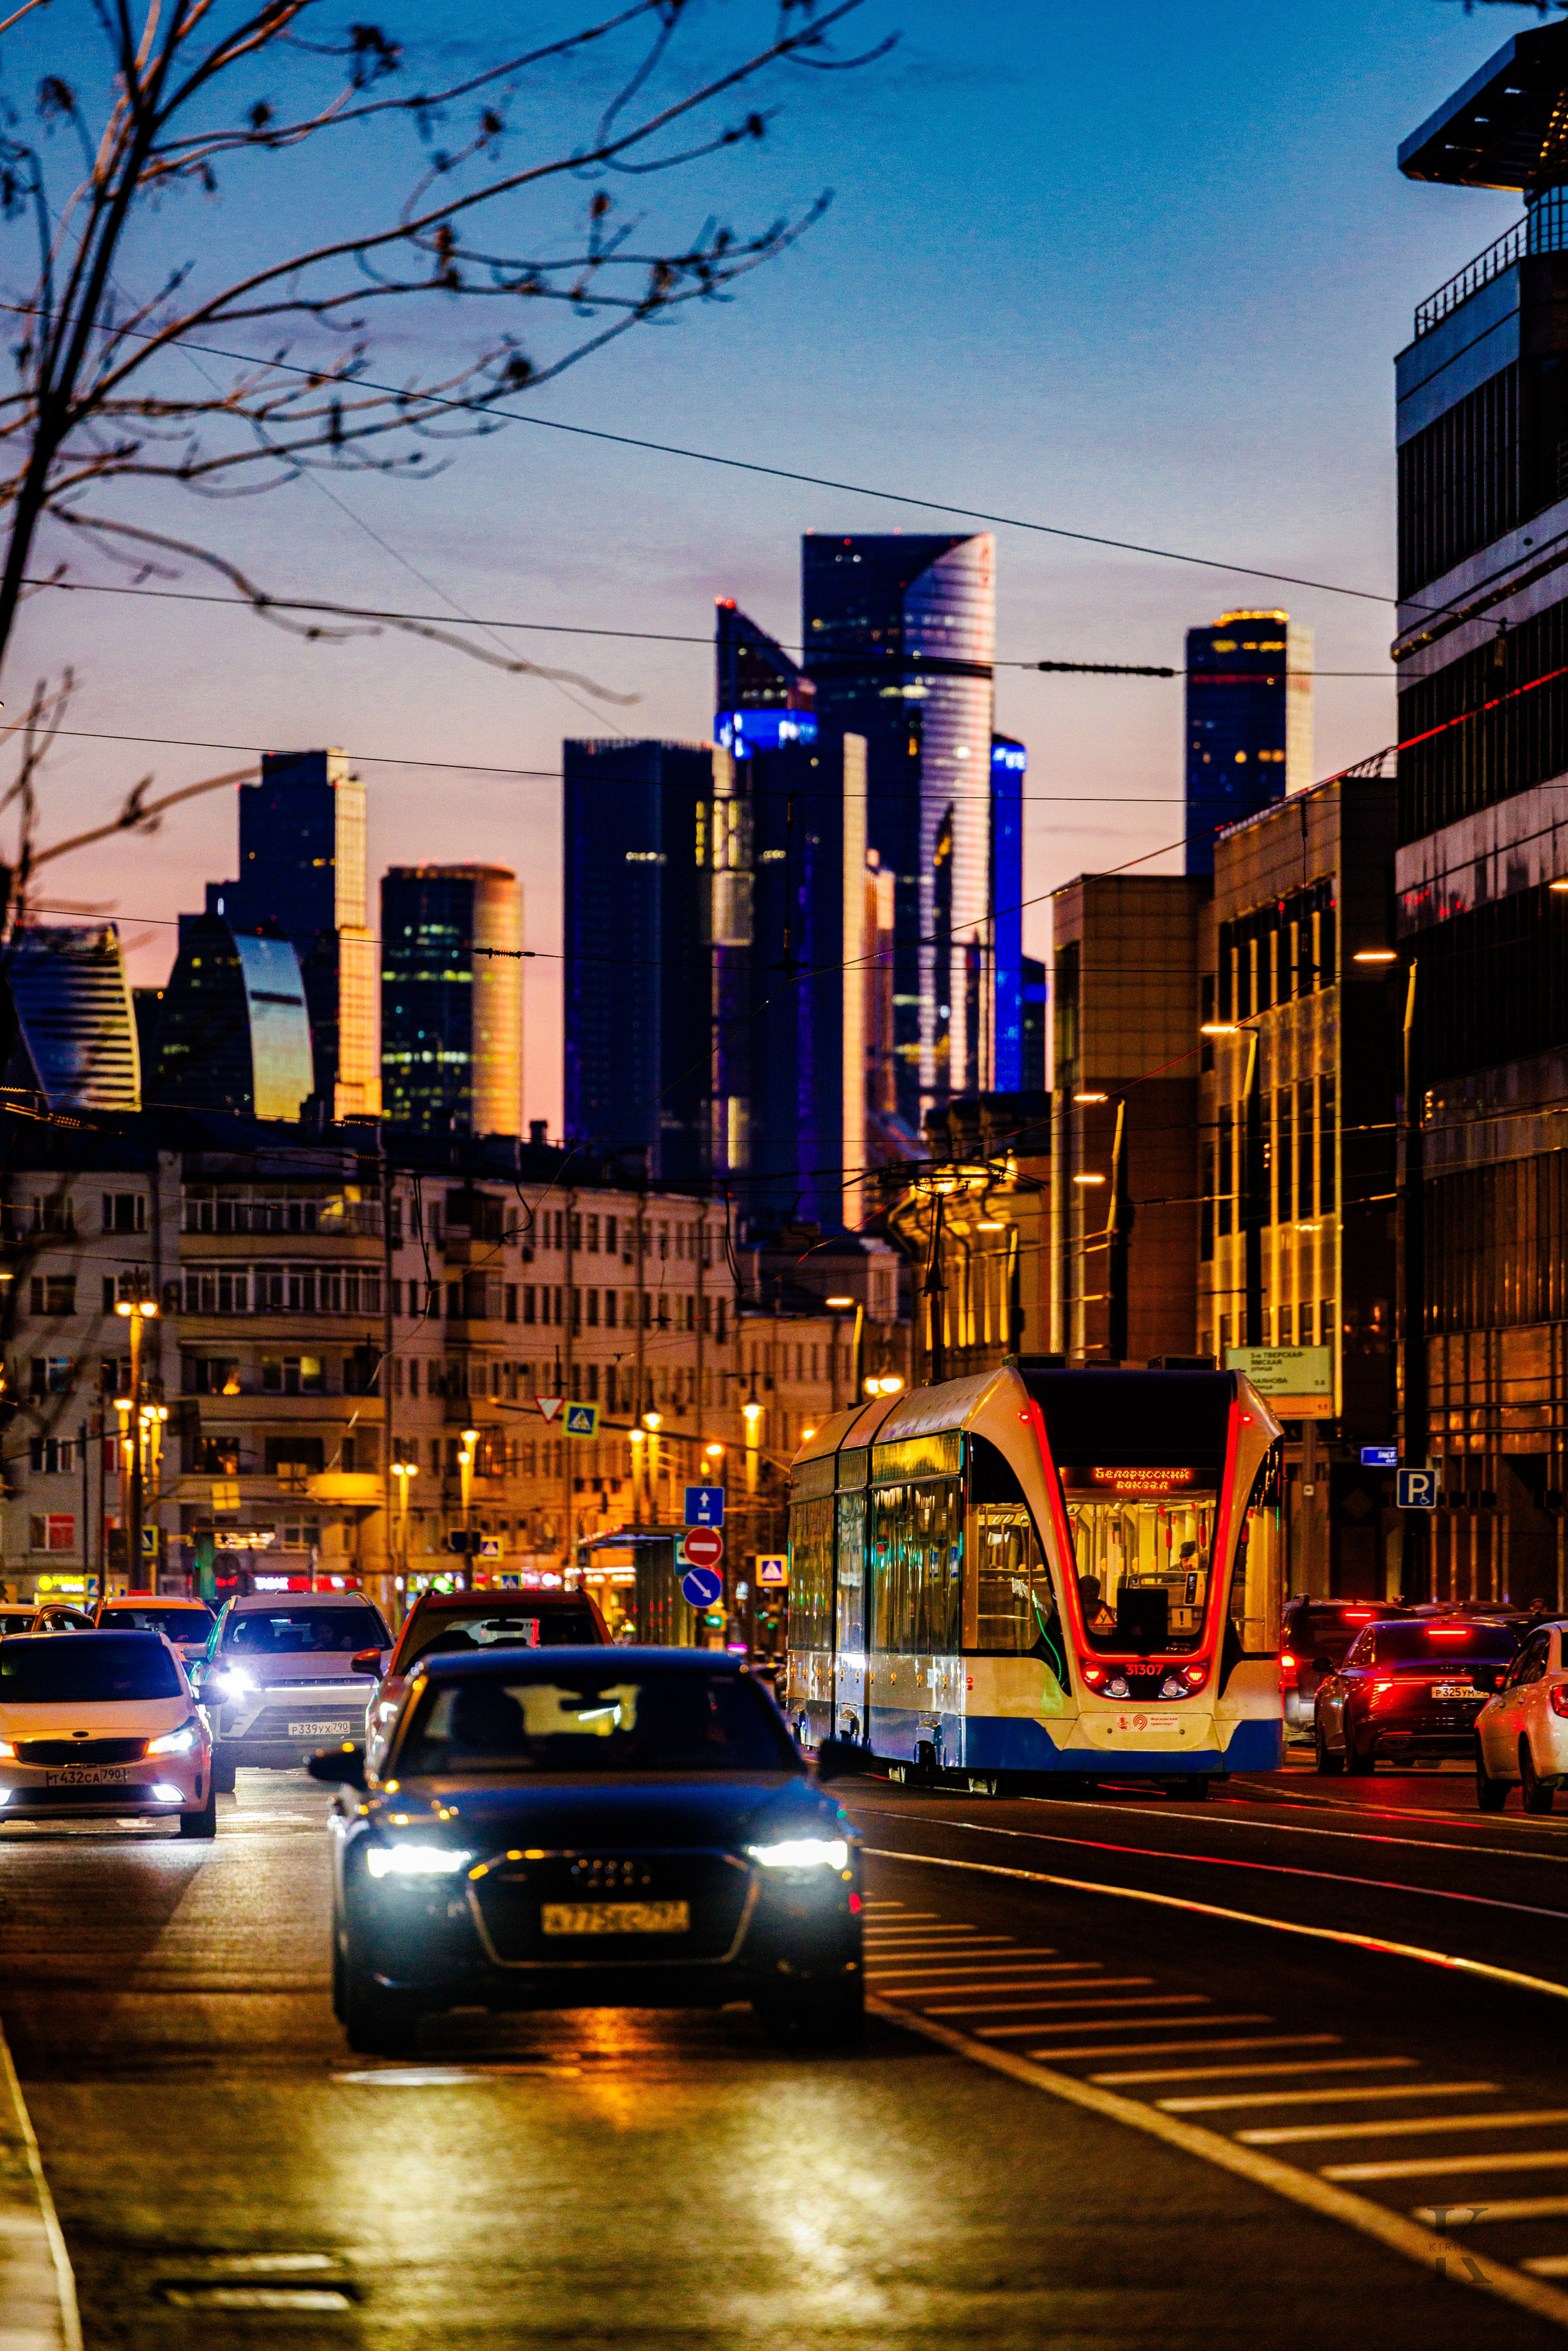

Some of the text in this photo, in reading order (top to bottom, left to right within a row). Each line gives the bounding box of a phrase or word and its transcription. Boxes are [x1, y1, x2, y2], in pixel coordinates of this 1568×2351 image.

[1095, 1468, 1189, 1479] Белорусский
[1408, 1474, 1430, 1503] P
[1125, 1664, 1164, 1675] 31307
